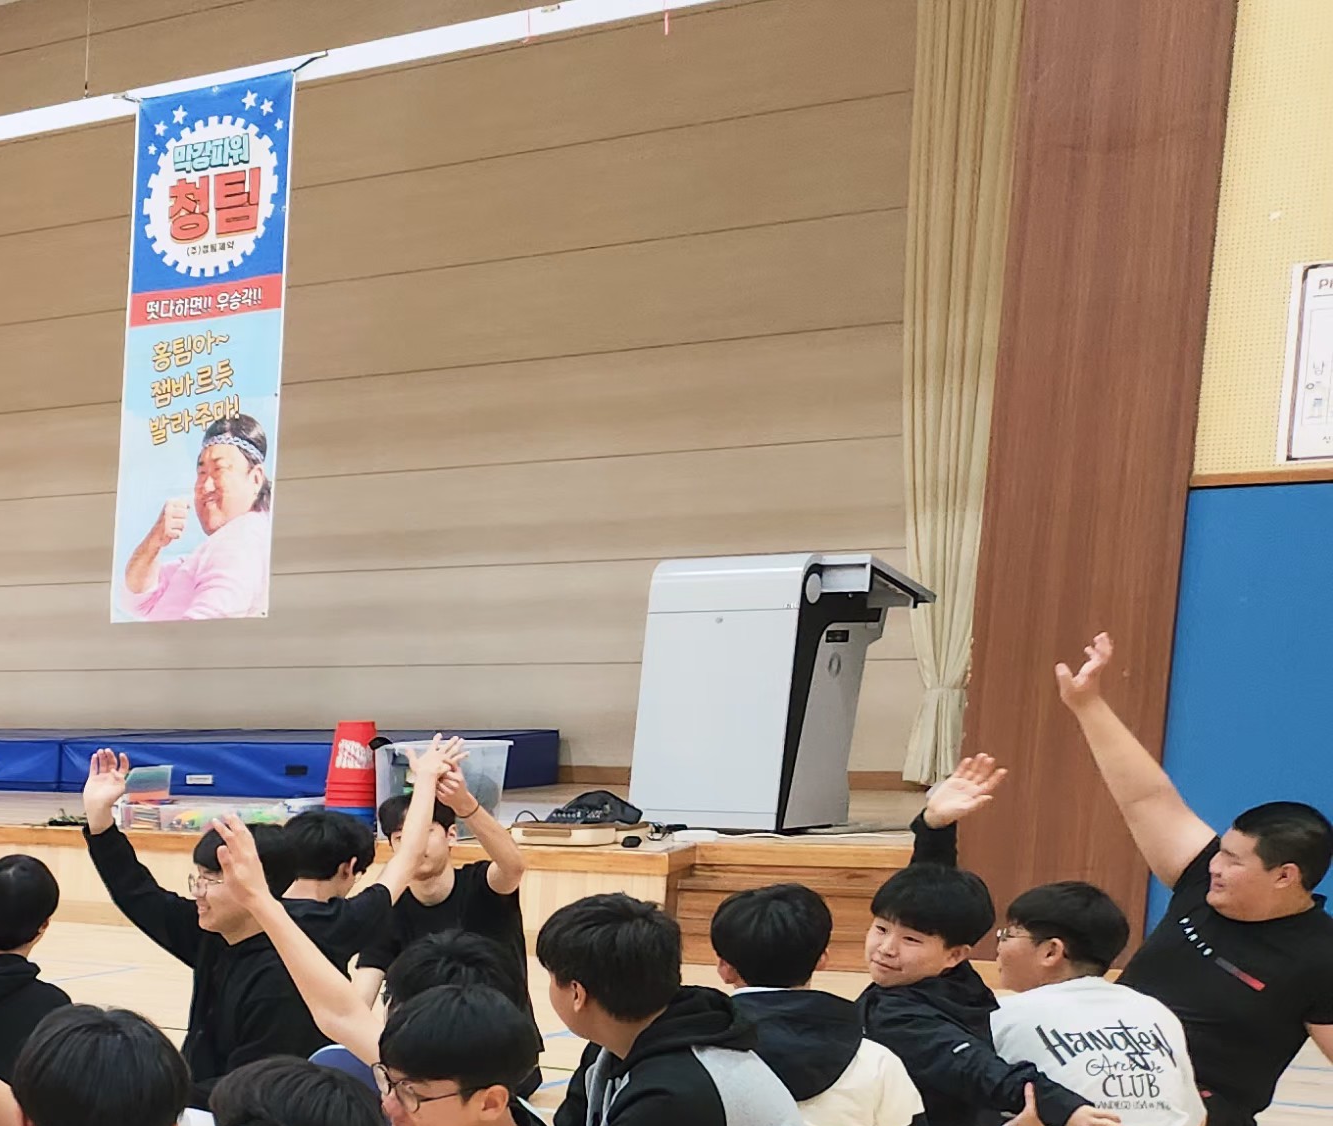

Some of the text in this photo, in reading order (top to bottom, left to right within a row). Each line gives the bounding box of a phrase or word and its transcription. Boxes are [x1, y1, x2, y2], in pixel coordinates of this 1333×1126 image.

[173, 133, 250, 173] 막강파워
[168, 167, 262, 244] 청팀
[215, 287, 263, 312] 우승각!!
[1178, 917, 1213, 956] PARIS
[1102, 1073, 1161, 1098] CLUB
